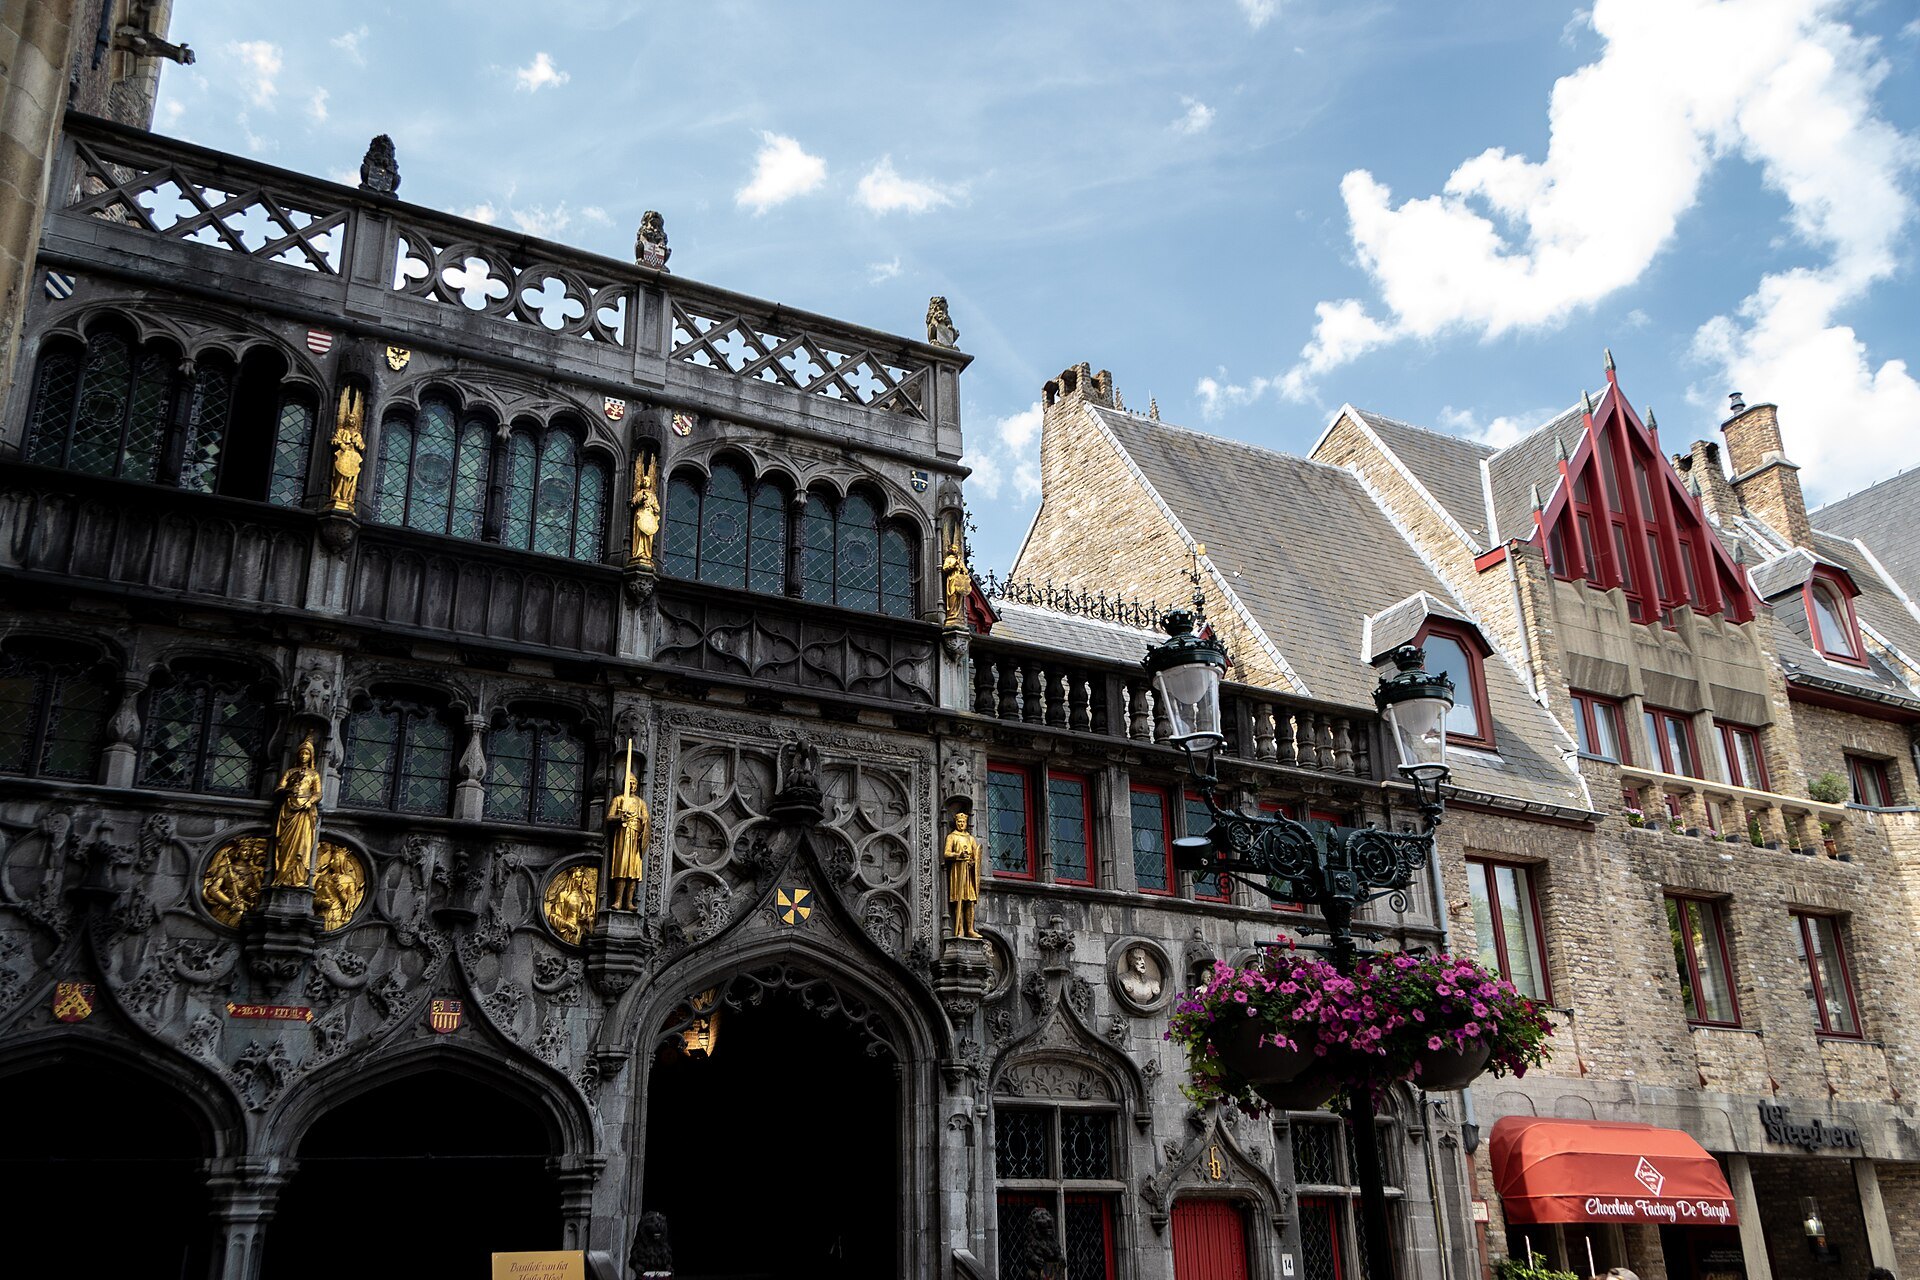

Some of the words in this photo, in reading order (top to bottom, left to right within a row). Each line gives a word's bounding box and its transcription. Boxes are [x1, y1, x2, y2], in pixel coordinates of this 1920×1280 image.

[1758, 1100, 1790, 1125] ter
[1766, 1119, 1857, 1152] steeghere
[1585, 1197, 1636, 1216] Chocolate
[1635, 1199, 1677, 1223] Factory
[1676, 1200, 1698, 1217] De
[1696, 1200, 1731, 1224] Burgh
[509, 1261, 542, 1273] Basiliek
[1284, 1259, 1292, 1270] 14
